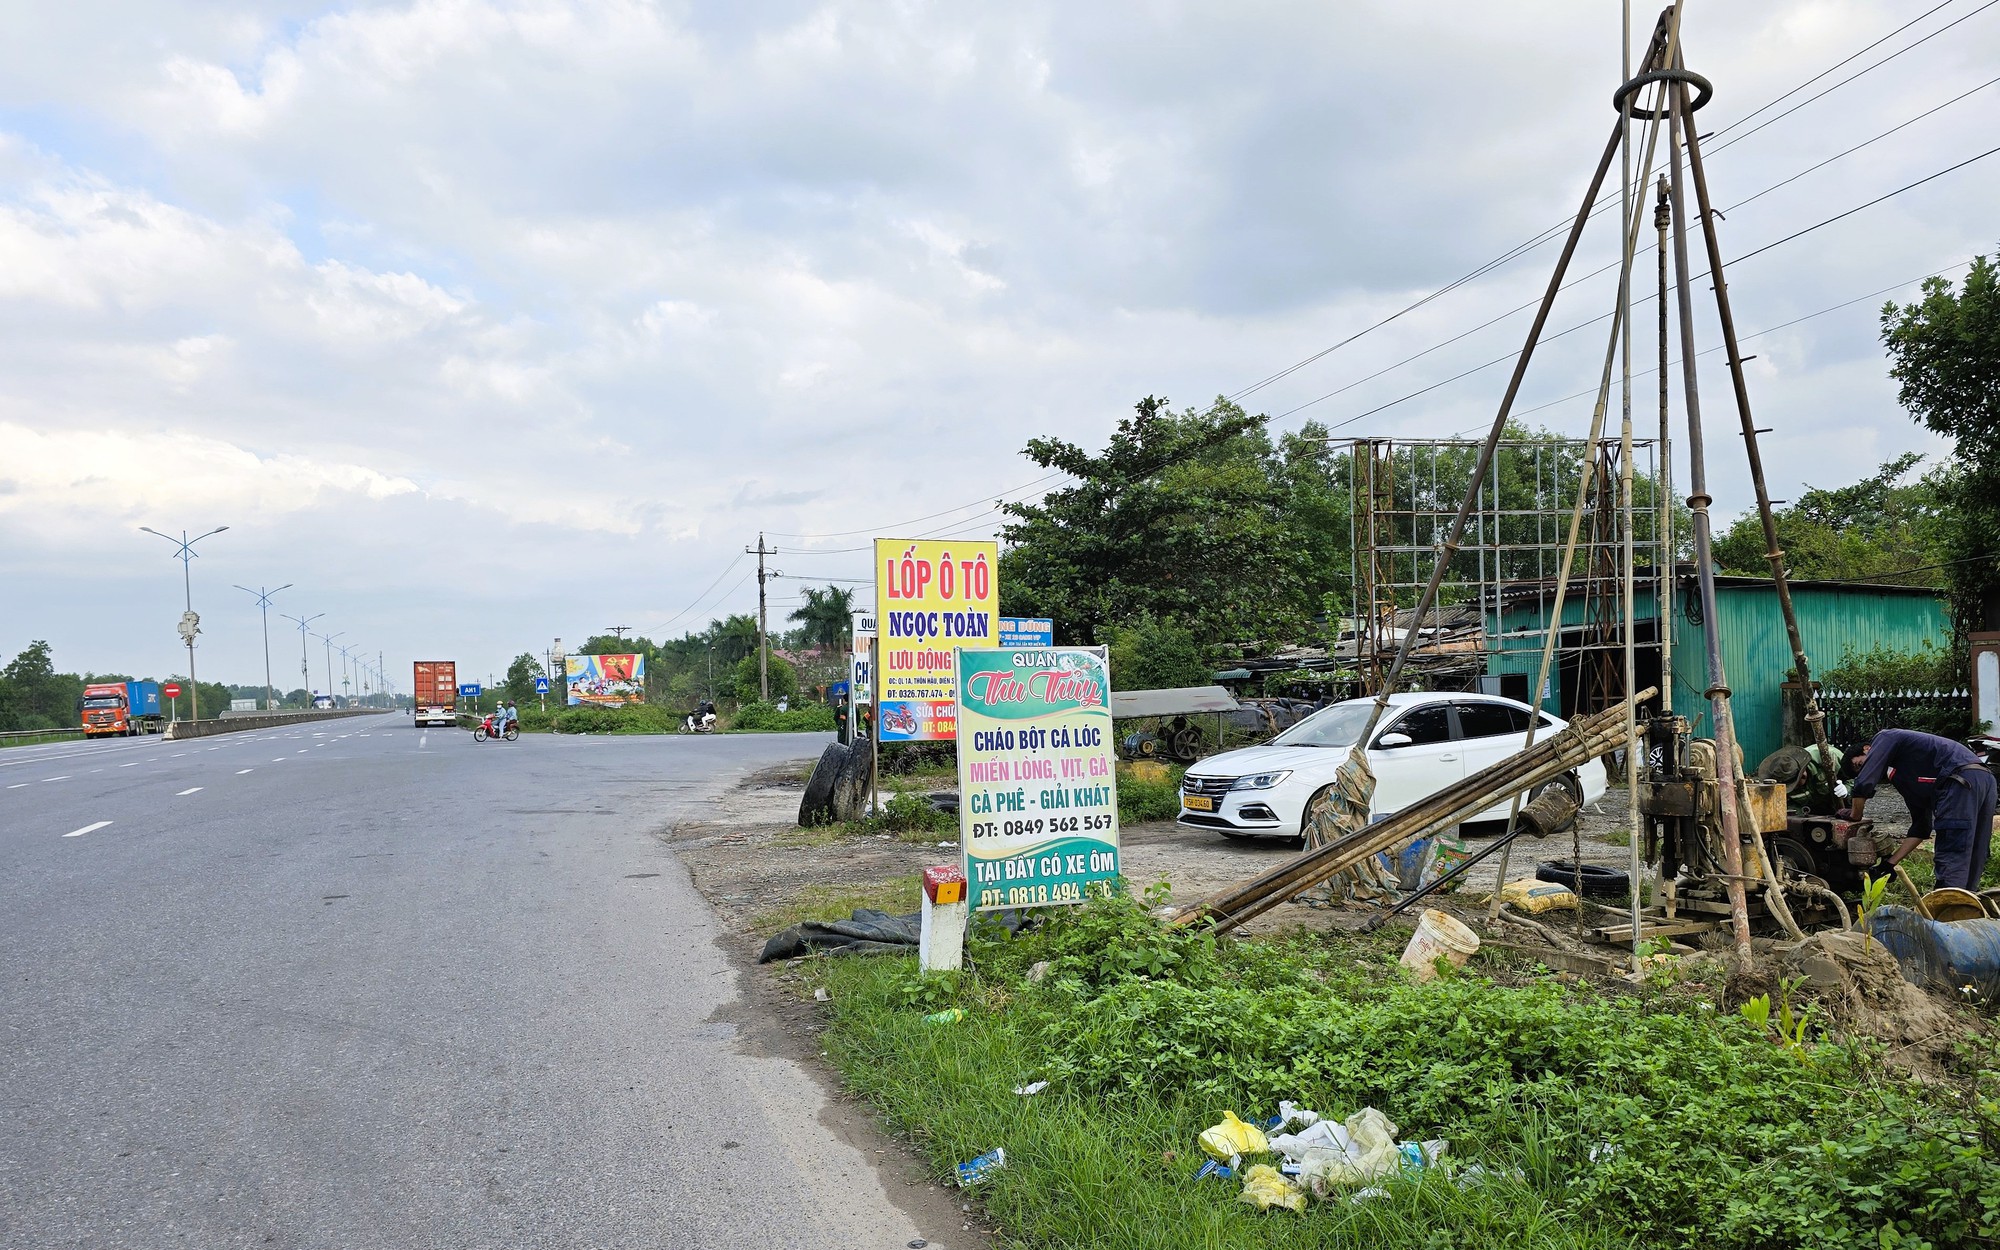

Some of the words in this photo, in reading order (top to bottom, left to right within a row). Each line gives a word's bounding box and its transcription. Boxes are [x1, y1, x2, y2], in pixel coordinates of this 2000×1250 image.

[887, 545, 932, 599] LỐP
[939, 552, 955, 600] Ô
[961, 553, 989, 600] TÔ
[889, 611, 939, 643] NGỌC
[942, 606, 989, 637] TOÀN
[889, 649, 914, 670] LƯU
[917, 647, 952, 674] ĐỘNG
[1012, 650, 1057, 668] QUÁN
[887, 689, 898, 699] ĐT:
[898, 689, 943, 699] 0326.767.474
[967, 669, 1028, 706] Thu
[1027, 669, 1103, 708] Thủy
[915, 702, 934, 718] SỬA
[922, 721, 935, 733] ĐT:
[974, 726, 1015, 752] CHÁO
[1019, 725, 1046, 754] BỘT
[1050, 724, 1071, 749] CÁ
[1074, 723, 1101, 748] LÓC
[969, 755, 1010, 783] MIẾN
[1014, 755, 1057, 781] LÒNG,
[1060, 757, 1085, 782] VỊT,
[1088, 752, 1109, 777] GÀ
[970, 788, 993, 814] CÀ
[995, 786, 1026, 813] PHÊ
[1040, 782, 1070, 810] GIẢI
[1073, 782, 1110, 808] KHÁT
[972, 821, 998, 839] ĐT:
[1003, 818, 1044, 836] 0849
[1049, 815, 1079, 833] 562
[1083, 813, 1112, 831] 567
[974, 860, 1001, 886] TẠI
[1004, 854, 1036, 880] ĐÂY
[1040, 852, 1062, 877] CÓ
[1065, 853, 1086, 875] XE
[1089, 849, 1115, 873] ÔM
[980, 888, 1005, 907] ĐT:
[1008, 884, 1048, 906] 0818
[1051, 882, 1081, 902] 494
